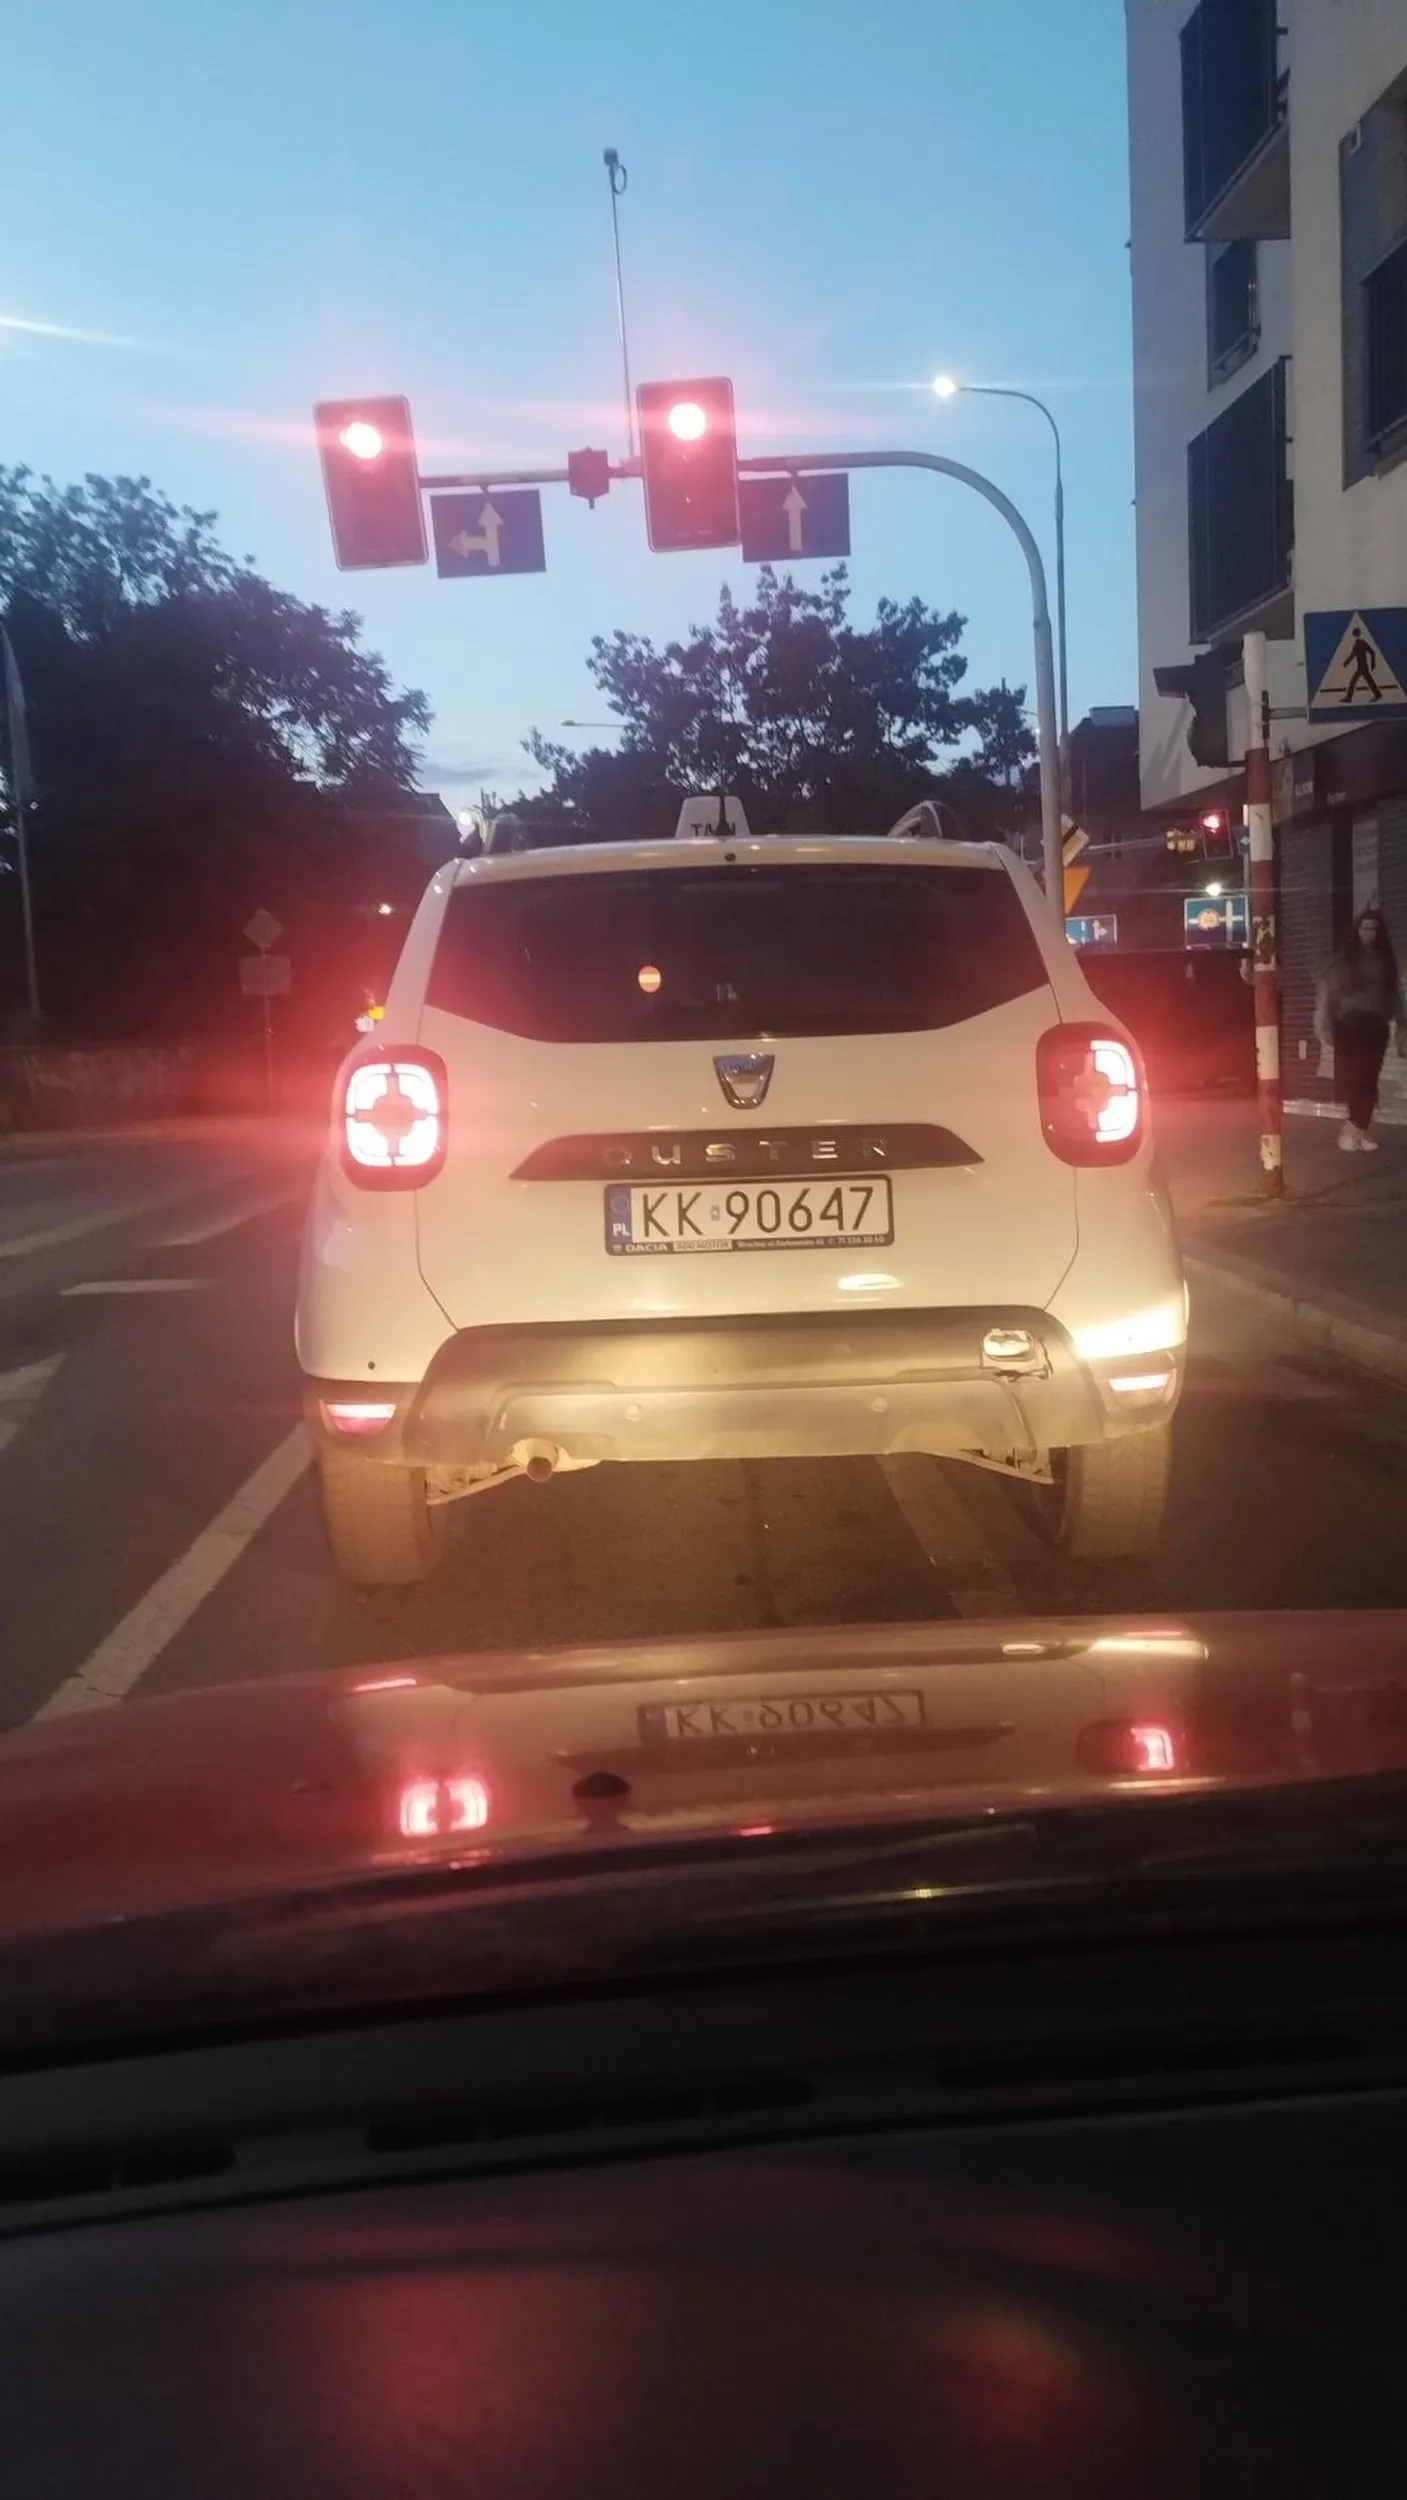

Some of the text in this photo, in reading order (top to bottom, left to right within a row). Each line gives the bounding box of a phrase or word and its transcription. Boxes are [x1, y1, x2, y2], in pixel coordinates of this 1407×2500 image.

[690, 823, 736, 837] TAI
[602, 1136, 886, 1165] DUSTER
[642, 1186, 874, 1238] KK 90647
[612, 1222, 631, 1237] PL
[625, 1243, 668, 1253] DACIA
